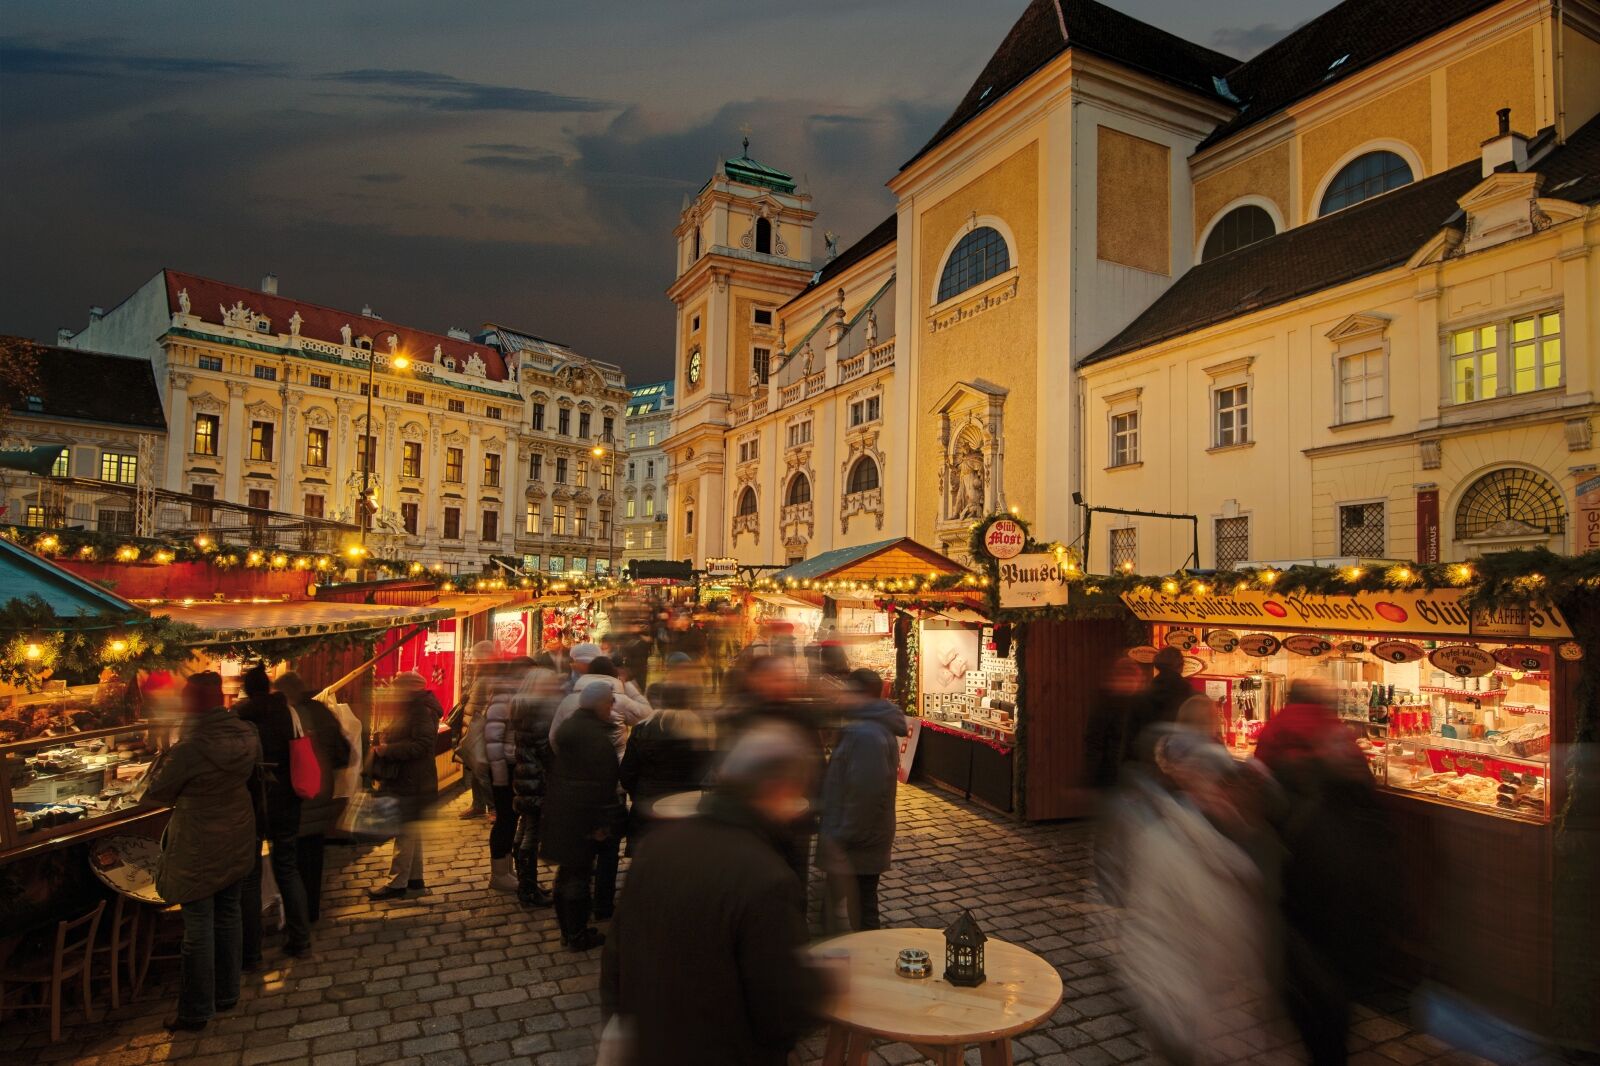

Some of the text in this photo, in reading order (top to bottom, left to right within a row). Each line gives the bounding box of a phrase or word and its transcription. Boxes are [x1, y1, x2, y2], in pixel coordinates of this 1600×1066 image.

[995, 521, 1016, 534] Glüh
[988, 531, 1022, 546] Most
[1000, 561, 1065, 590] Punsch
[1488, 608, 1527, 625] KAFFEE
